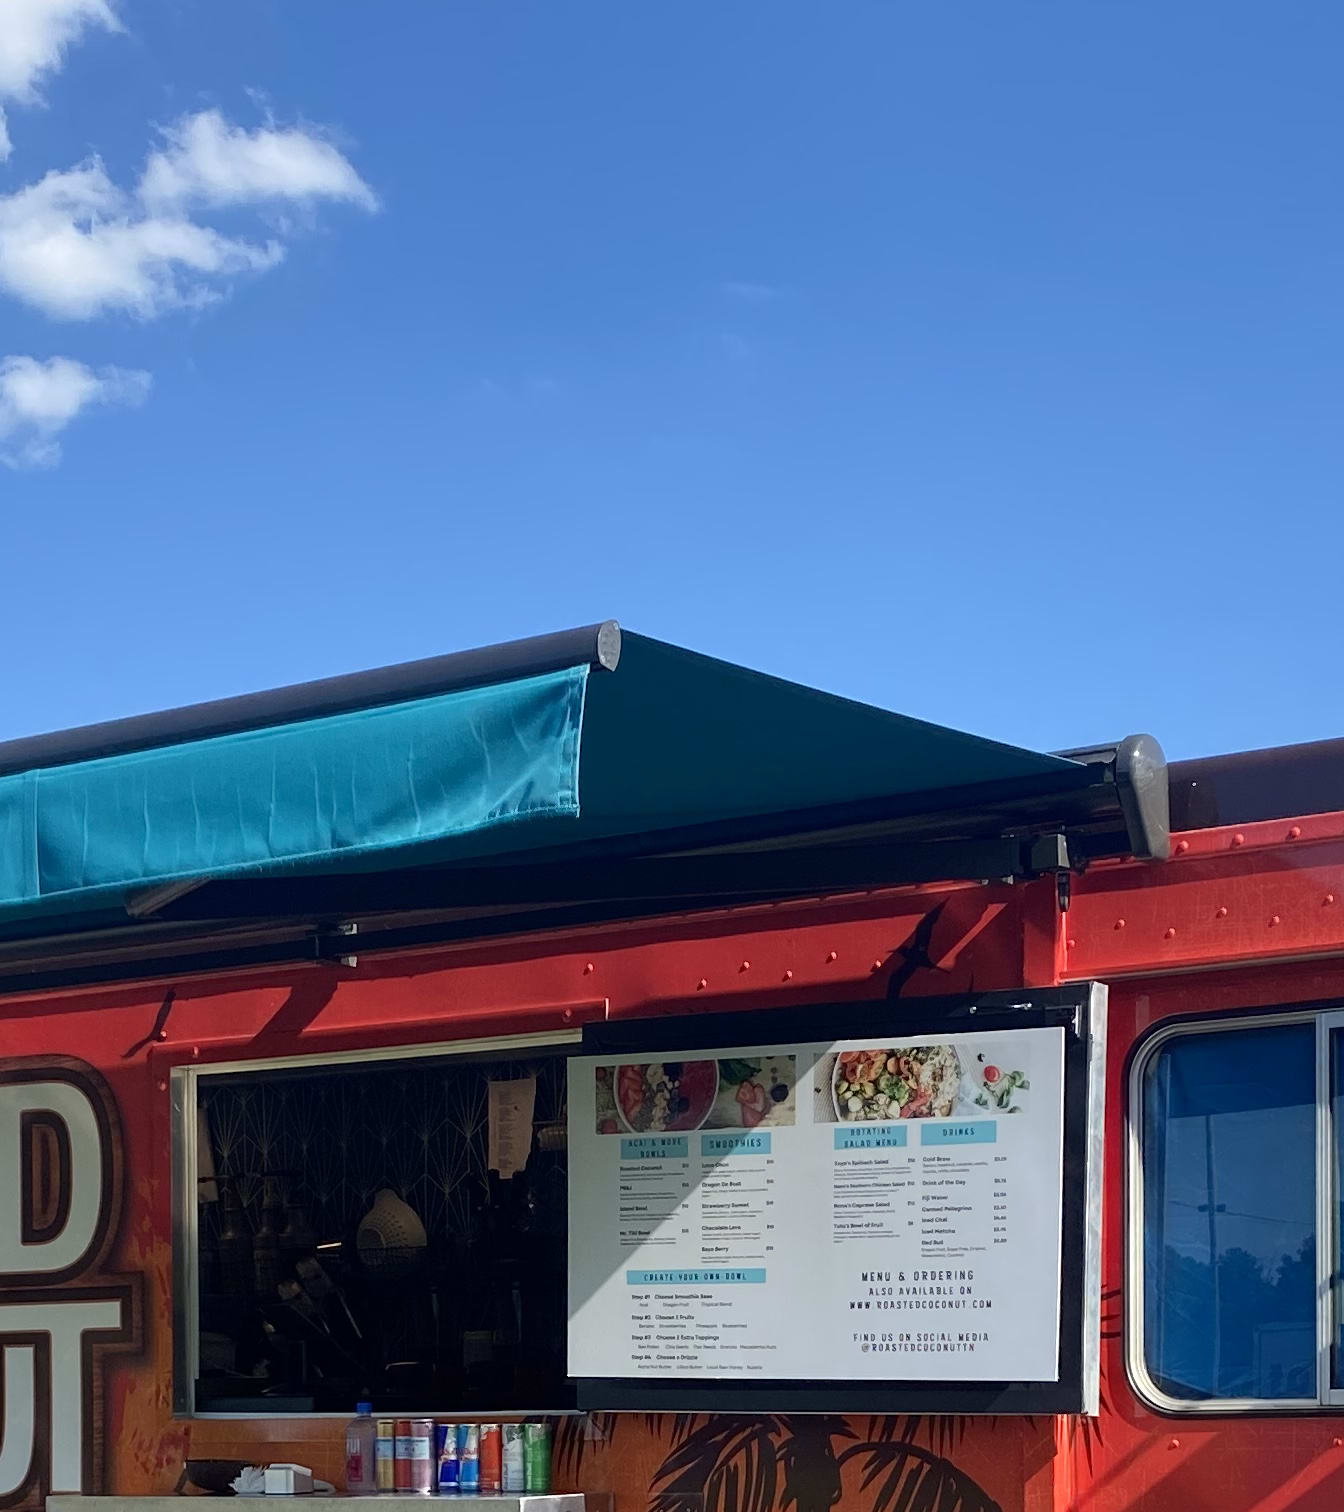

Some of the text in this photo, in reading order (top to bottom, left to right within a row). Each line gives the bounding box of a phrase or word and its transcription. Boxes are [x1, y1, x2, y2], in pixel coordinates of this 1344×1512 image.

[943, 1127, 975, 1137] DRINKS
[709, 1138, 762, 1149] SMOOTHIES
[876, 1138, 897, 1147] MENU
[643, 1273, 673, 1281] CREATE
[678, 1273, 699, 1281] YOUR
[861, 1270, 974, 1282] MENU & ORDERING
[868, 1286, 972, 1296] ALSO AVAILABLE ON
[853, 1333, 989, 1342] FIND US ON SOCIAL MEDIA
[861, 1343, 975, 1352] @ROASTEDCOCONUTTN
